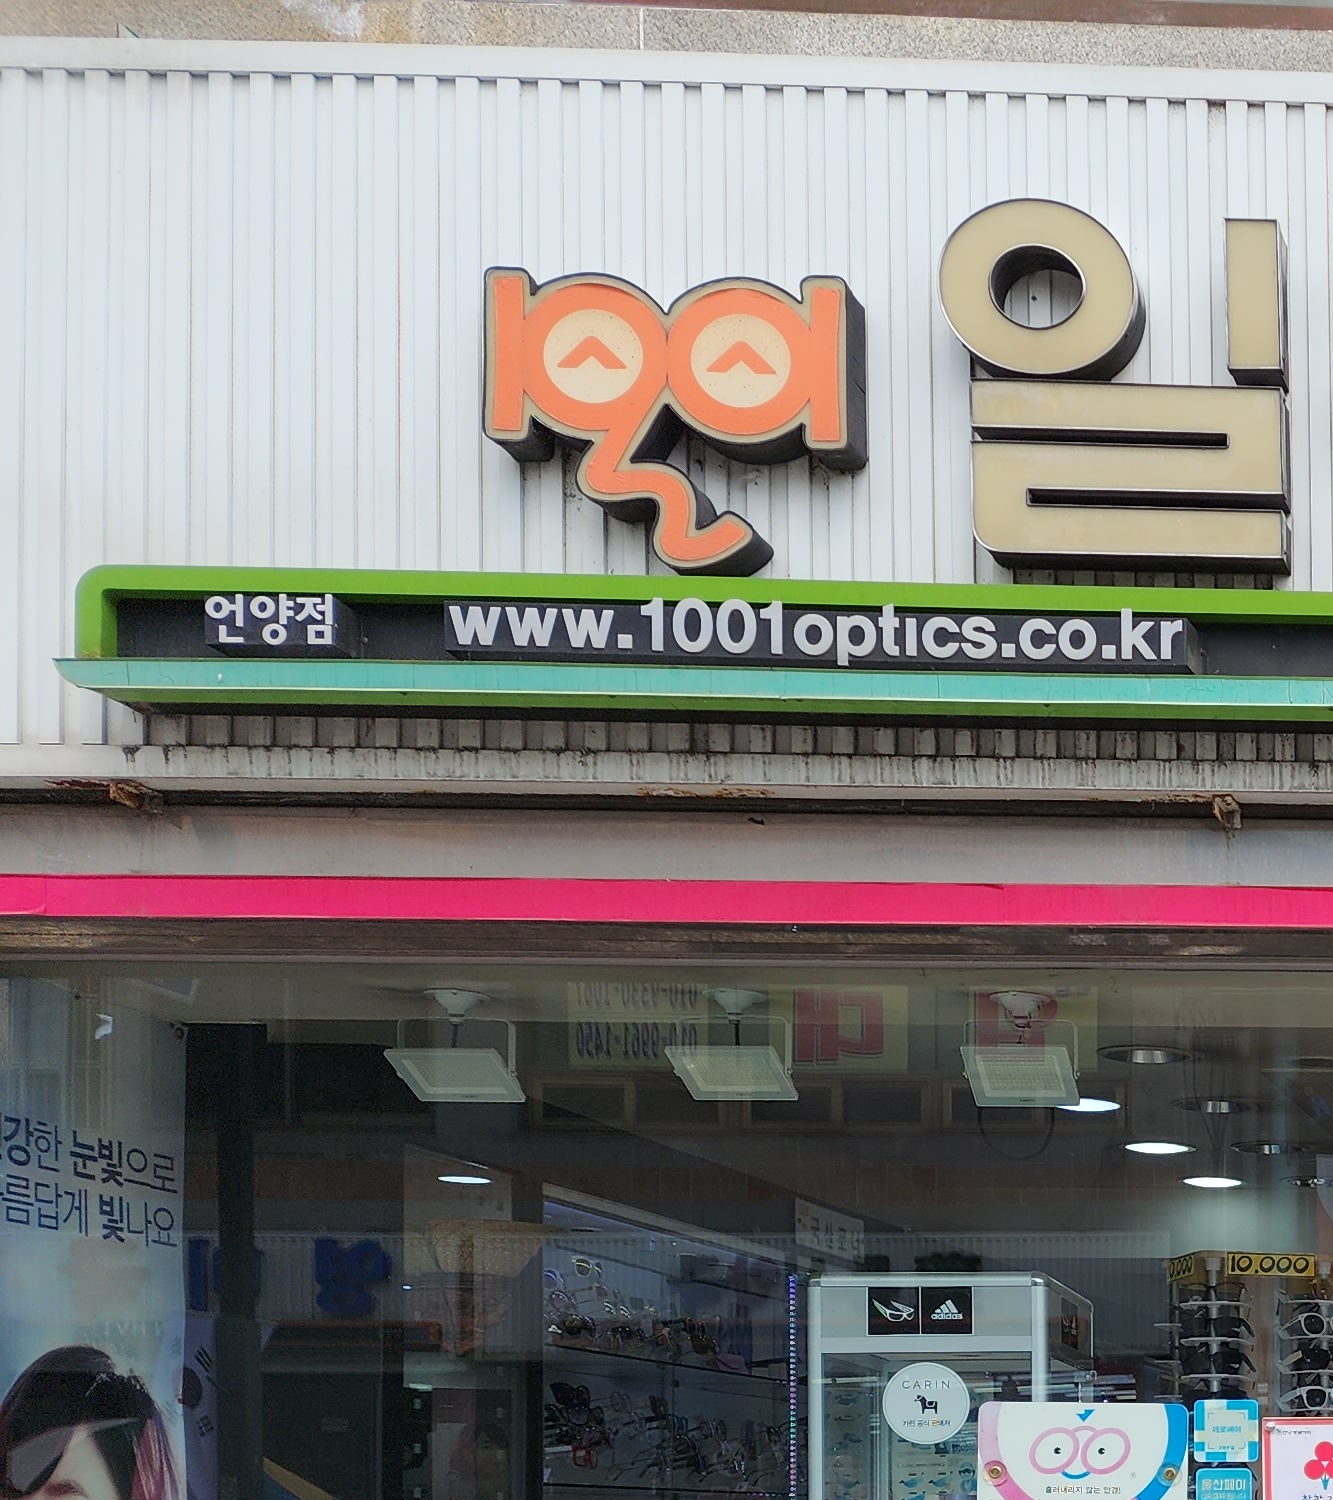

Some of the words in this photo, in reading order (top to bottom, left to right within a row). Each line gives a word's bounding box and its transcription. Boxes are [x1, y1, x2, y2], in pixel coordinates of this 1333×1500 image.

[205, 592, 335, 648] 언양점
[449, 597, 1187, 666] www.1001optics.co.kr
[0, 1116, 62, 1173] 강한
[69, 1129, 178, 1194] 눈빛으로
[0, 1173, 90, 1237] 름답게
[99, 1193, 178, 1248] 빛나요
[1230, 1255, 1310, 1274] 10.000
[902, 1380, 950, 1389] CARIN
[1202, 1478, 1247, 1492] 울산페이
